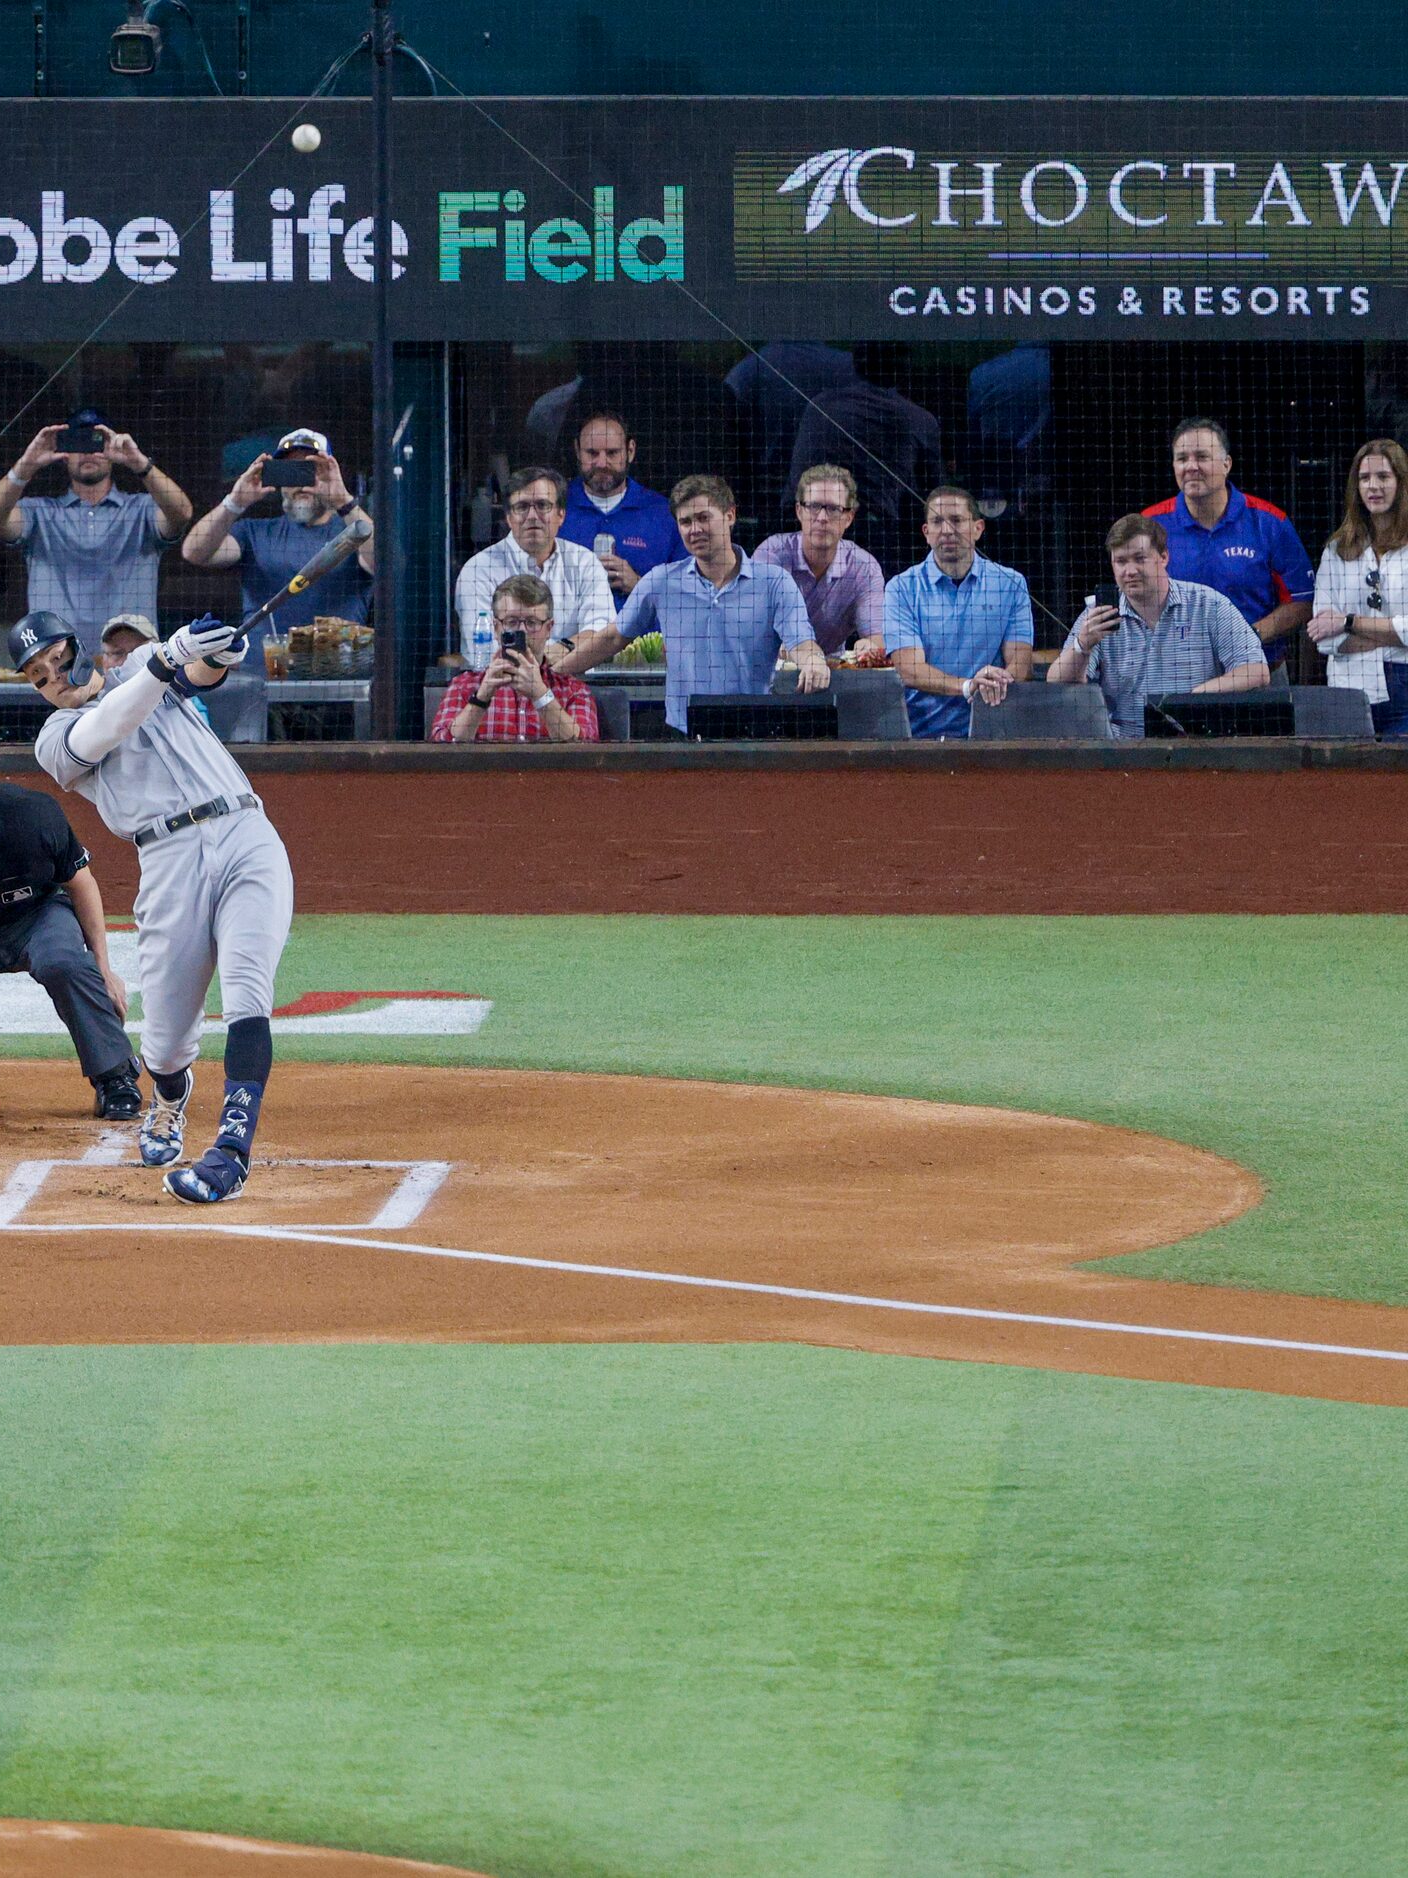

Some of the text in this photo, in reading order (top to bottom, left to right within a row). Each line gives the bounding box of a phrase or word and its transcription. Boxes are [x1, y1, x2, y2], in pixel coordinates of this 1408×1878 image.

[843, 146, 1408, 228] CHOCTAW
[209, 184, 410, 284] Life
[438, 185, 685, 284] Field
[889, 286, 1371, 316] CASINOS & RESORTS
[1223, 546, 1256, 559] TEXAS
[20, 628, 39, 648] NY
